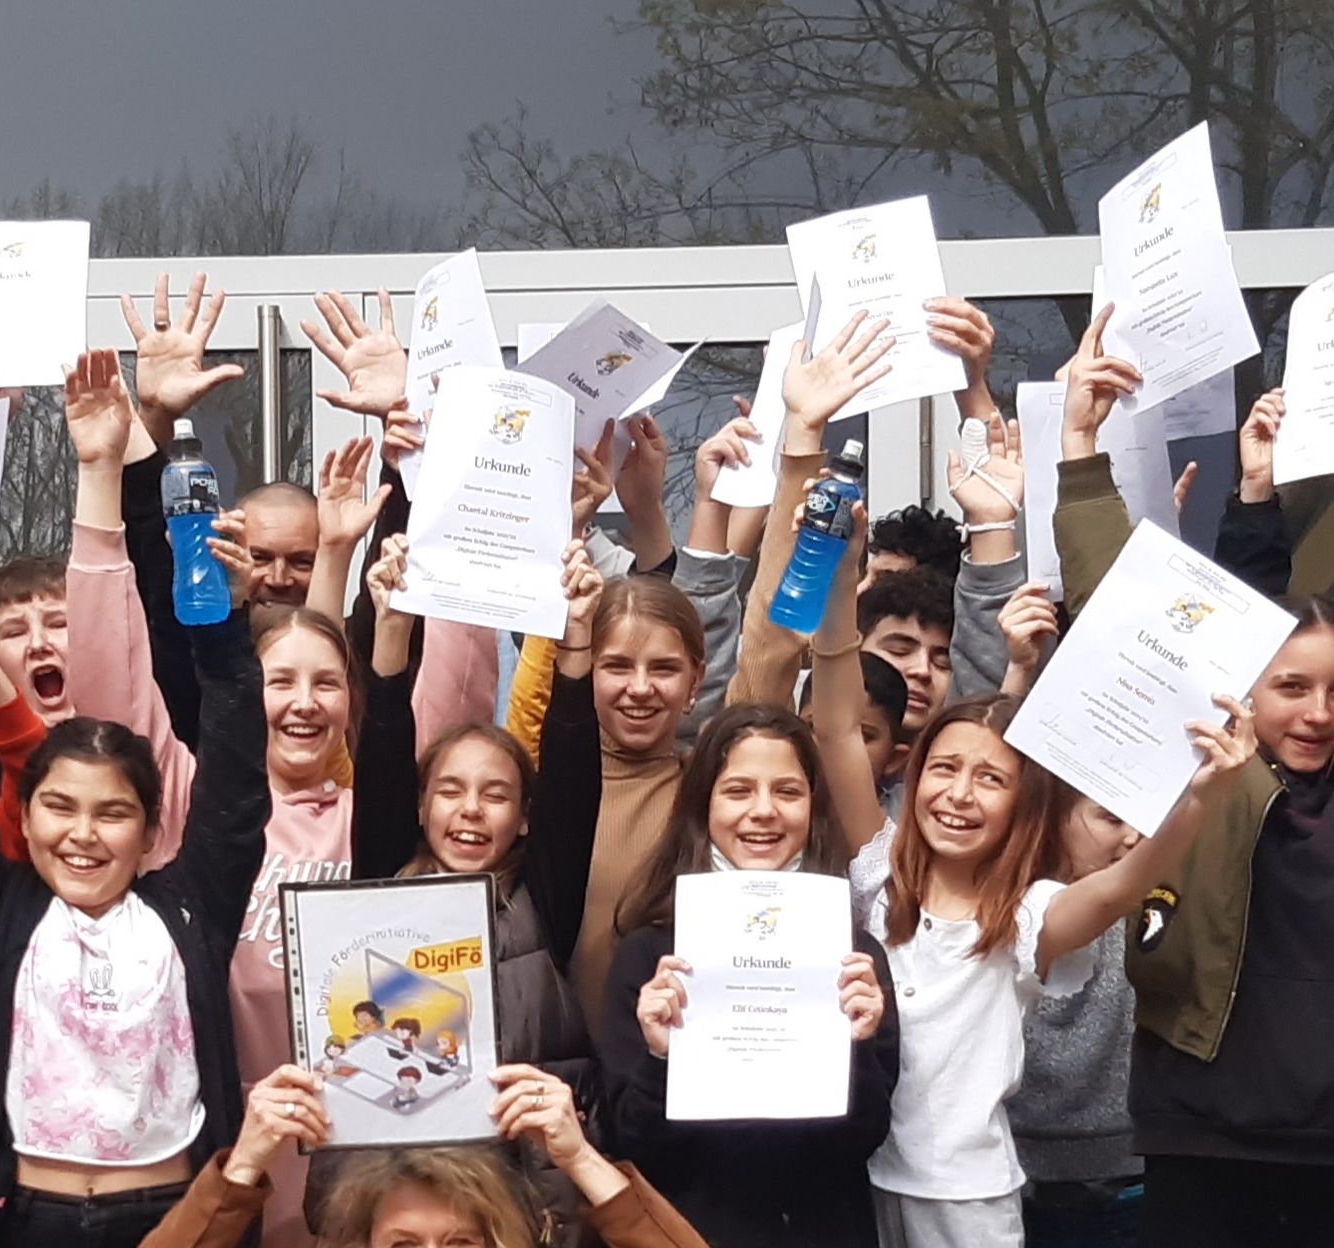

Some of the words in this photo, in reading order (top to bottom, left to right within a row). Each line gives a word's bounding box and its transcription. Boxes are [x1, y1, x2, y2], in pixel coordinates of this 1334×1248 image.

[474, 455, 532, 478] Urkunde
[457, 503, 489, 517] Chantal
[1137, 628, 1189, 672] Urkunde
[413, 945, 483, 973] DigiFö
[732, 955, 792, 970] Urkunde
